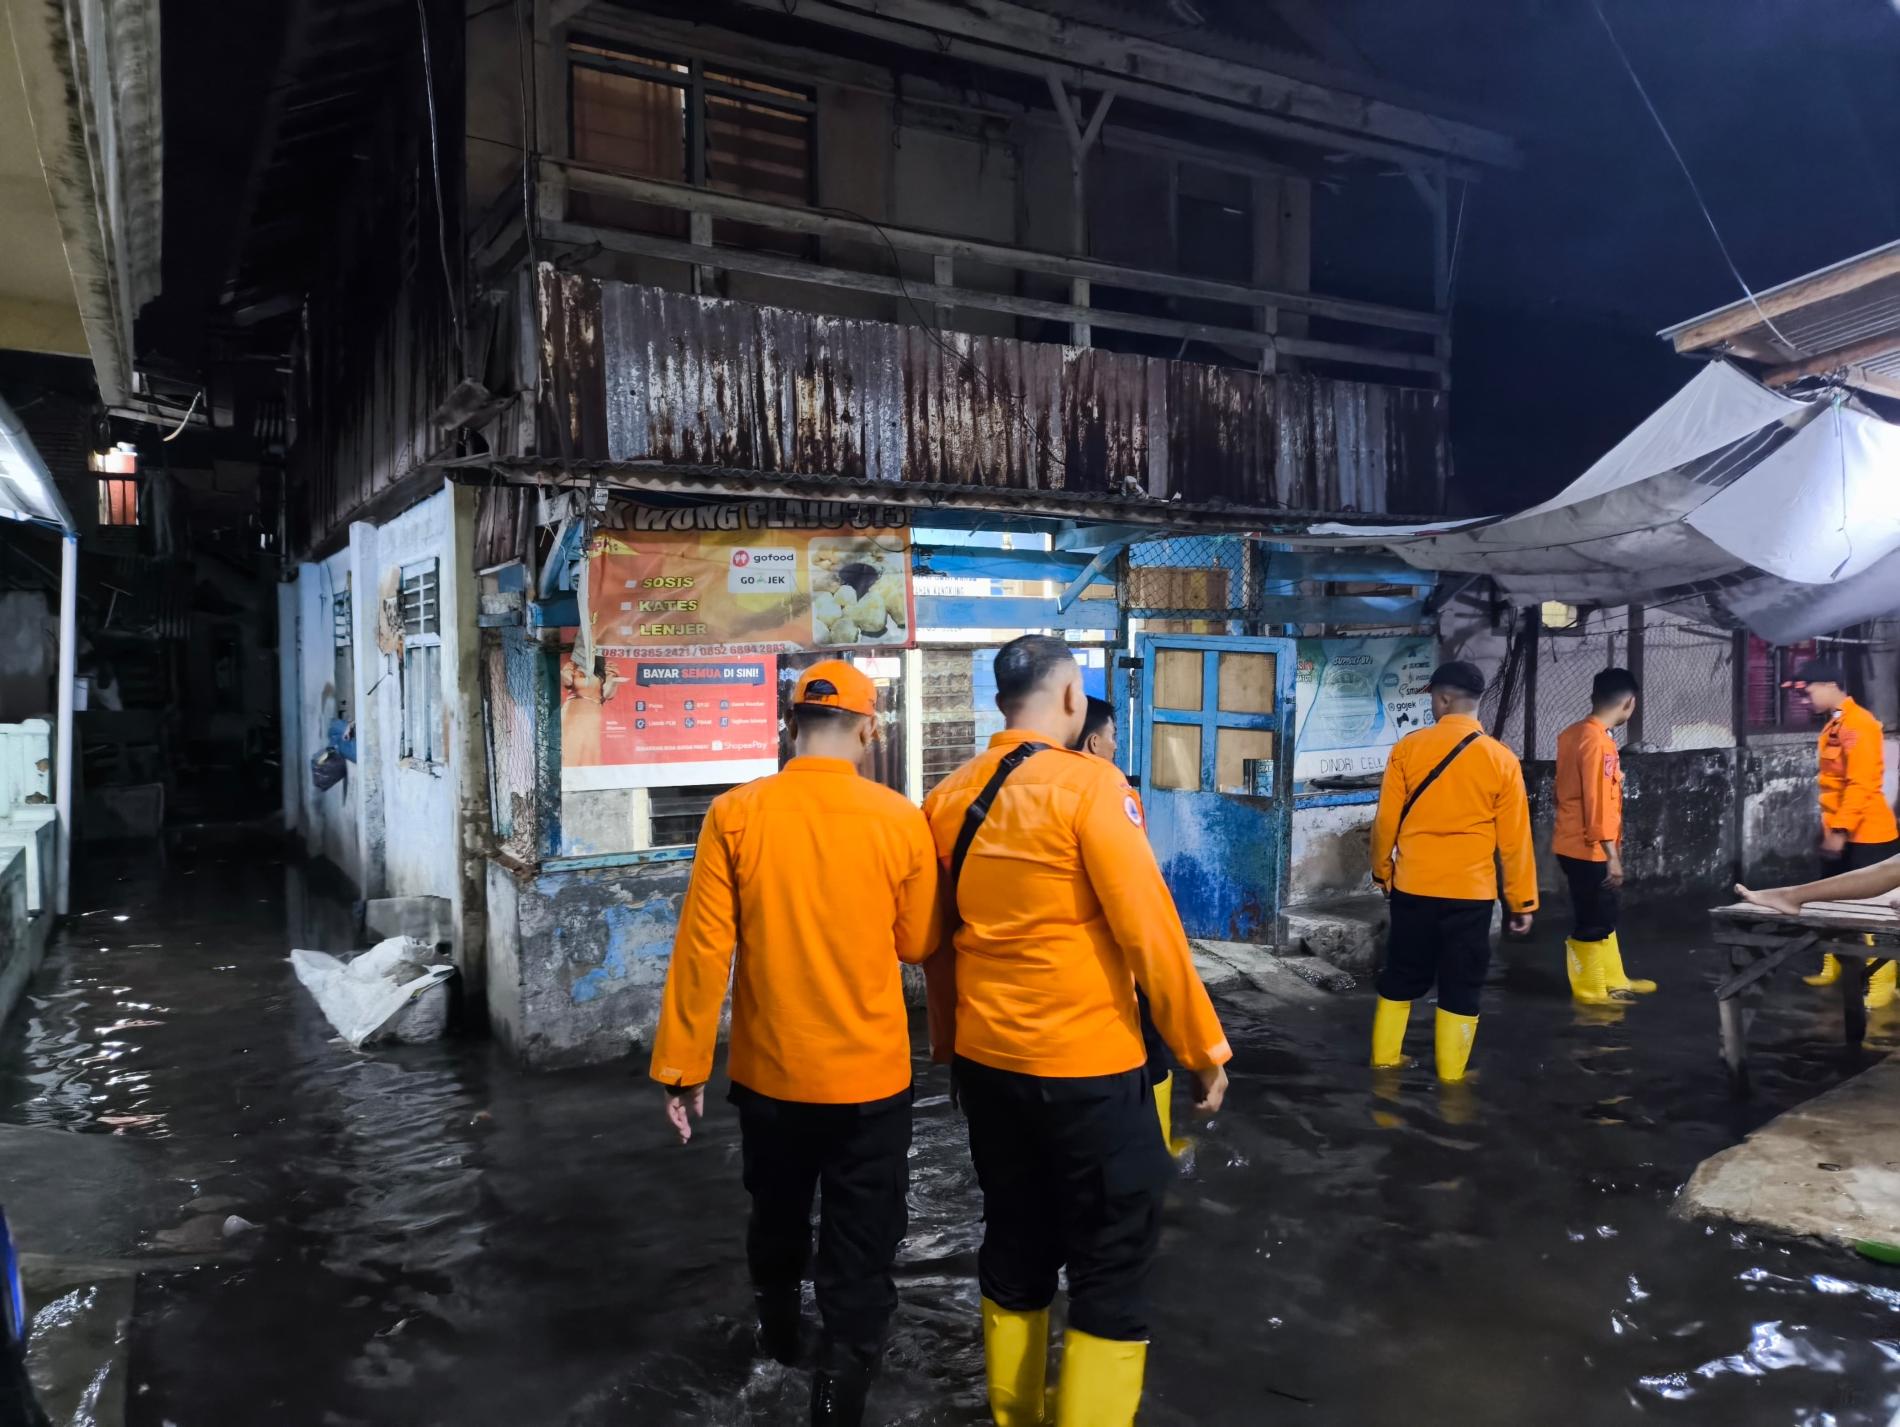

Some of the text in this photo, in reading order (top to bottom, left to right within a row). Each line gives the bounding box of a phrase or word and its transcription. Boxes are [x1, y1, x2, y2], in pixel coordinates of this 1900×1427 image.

[634, 504, 740, 531] WONG
[753, 553, 794, 563] gofood
[642, 576, 694, 588] SOSIS
[639, 600, 698, 612] KATES
[640, 623, 707, 636] LENJER
[643, 668, 679, 679] BAYAR
[681, 668, 721, 678] SEMUA
[723, 668, 734, 678] DI
[1396, 701, 1417, 711] gojek
[724, 740, 767, 752] ShopeePay
